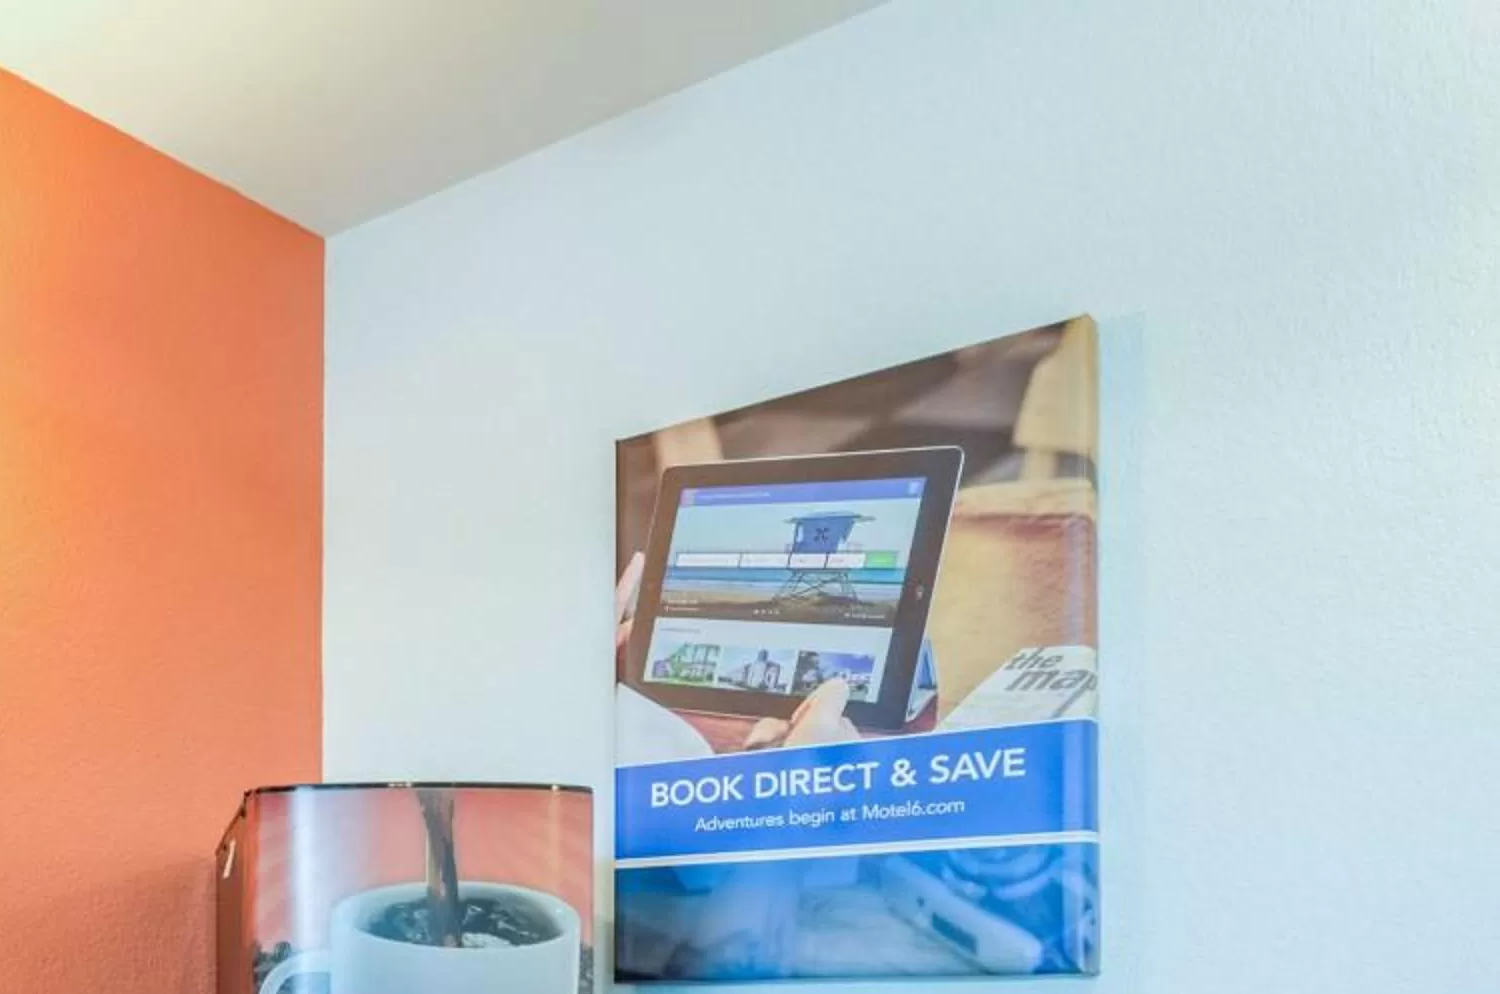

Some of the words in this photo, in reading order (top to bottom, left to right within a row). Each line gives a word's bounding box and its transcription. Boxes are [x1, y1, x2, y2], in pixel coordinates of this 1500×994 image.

[1003, 647, 1064, 671] the
[651, 774, 745, 808] BOOK
[755, 761, 880, 799] DIRECT
[890, 758, 918, 788] &
[929, 747, 1027, 785] SAVE
[694, 814, 785, 833] Adventures
[788, 807, 836, 828] begin
[840, 805, 857, 822] at
[862, 799, 965, 821] Motel6.com
